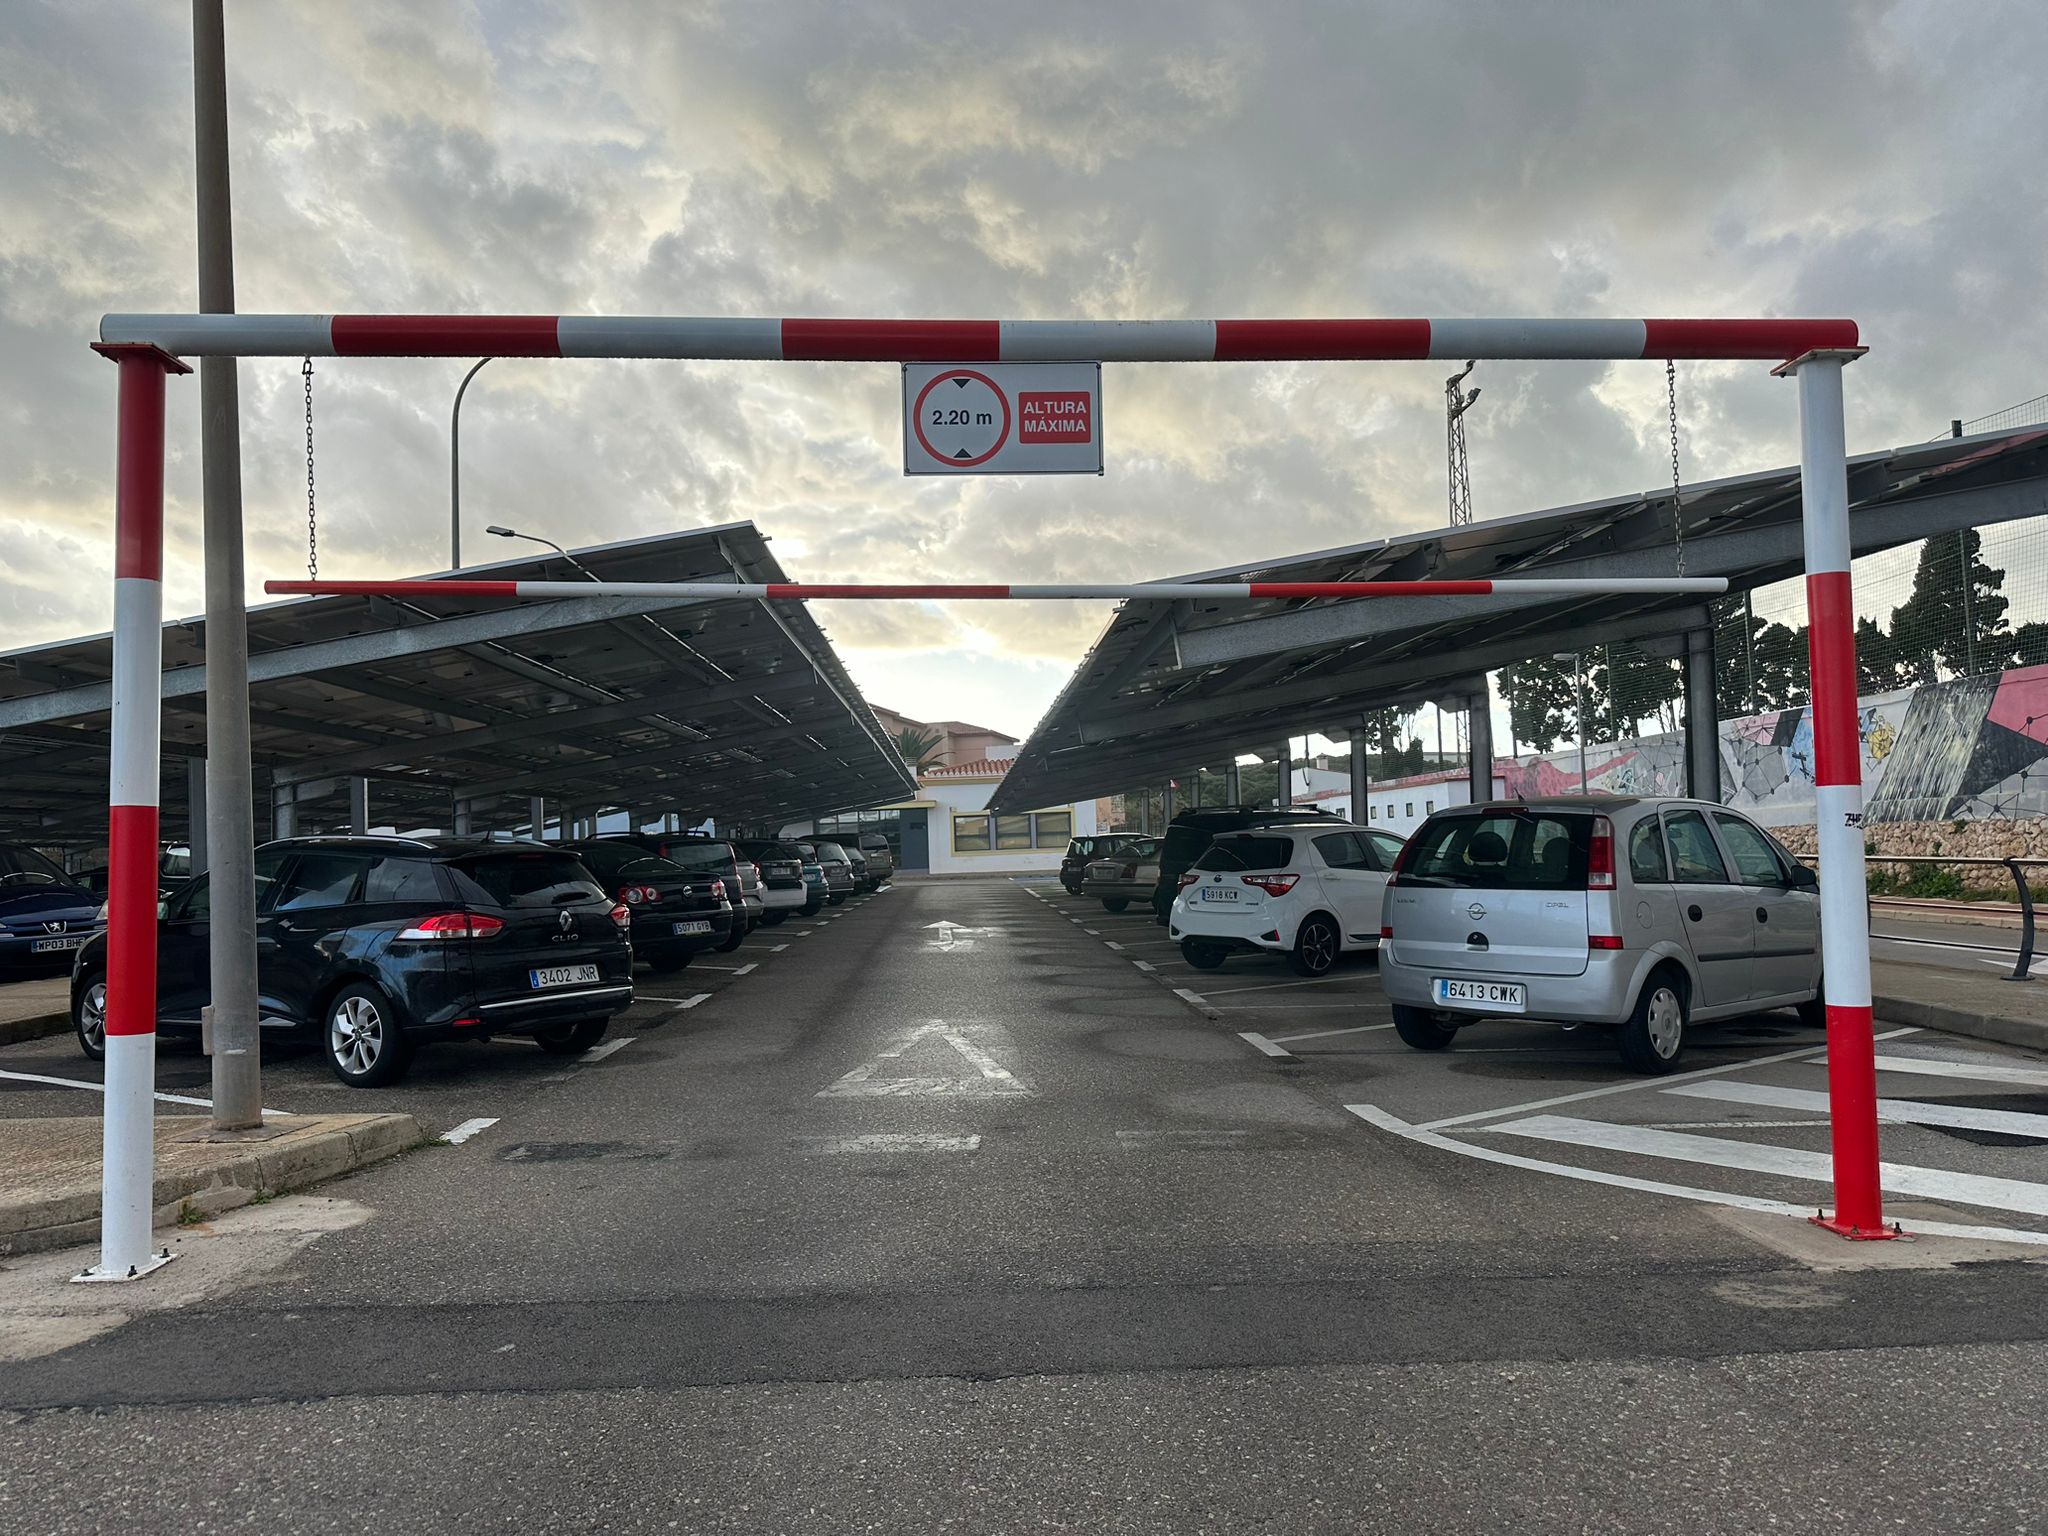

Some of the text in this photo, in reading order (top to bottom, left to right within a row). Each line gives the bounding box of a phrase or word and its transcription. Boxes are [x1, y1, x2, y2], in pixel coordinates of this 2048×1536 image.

[1024, 401, 1087, 414] ALTURA
[932, 410, 992, 425] 2.20 m
[1024, 416, 1087, 433] MÁXIMA
[1206, 890, 1238, 899] 5918 KCW
[677, 922, 695, 933] 5071
[551, 933, 579, 942] CLIO
[540, 966, 597, 984] 3402 JNR
[1449, 982, 1518, 1003] 6413 CWK
